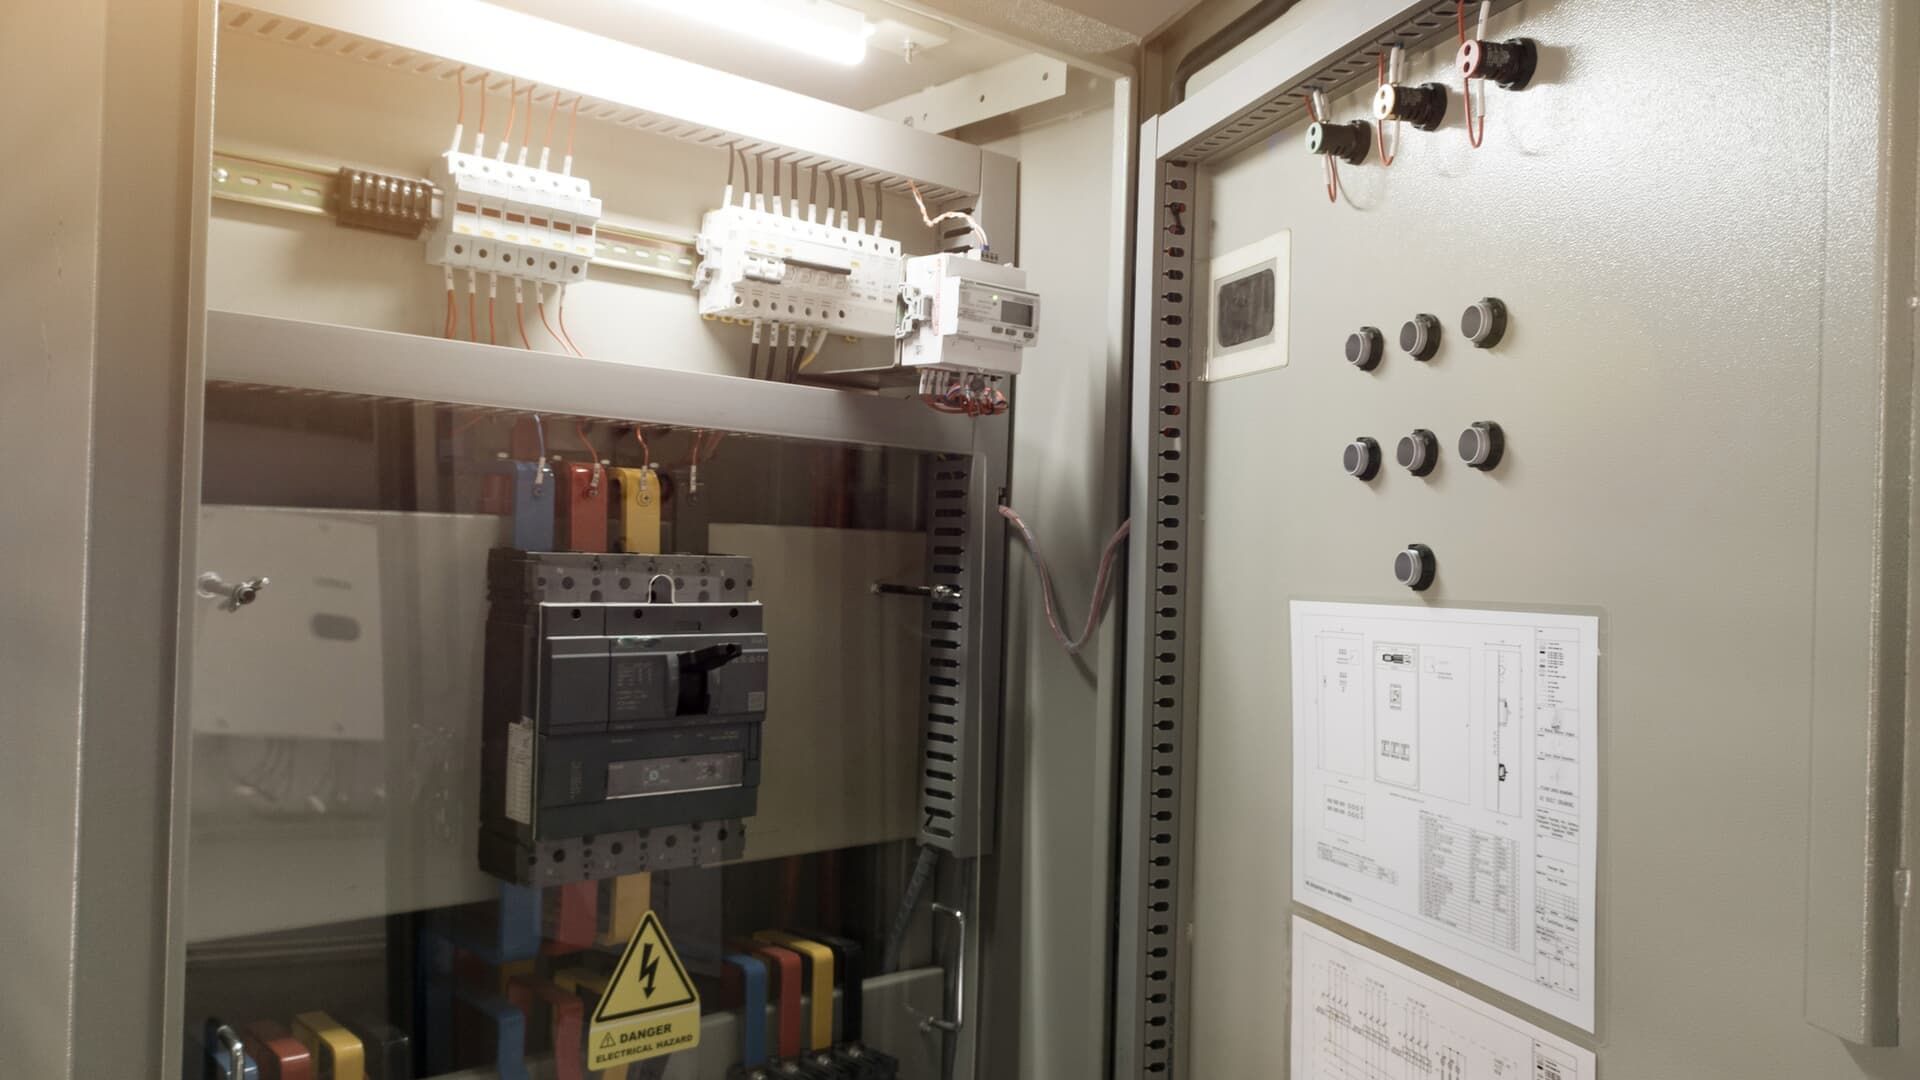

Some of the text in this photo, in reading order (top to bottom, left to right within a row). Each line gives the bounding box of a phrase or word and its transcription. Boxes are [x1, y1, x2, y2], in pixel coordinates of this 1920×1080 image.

[620, 1024, 671, 1043] DANGER
[596, 1034, 693, 1063] ELECTRICAL HAZARD
